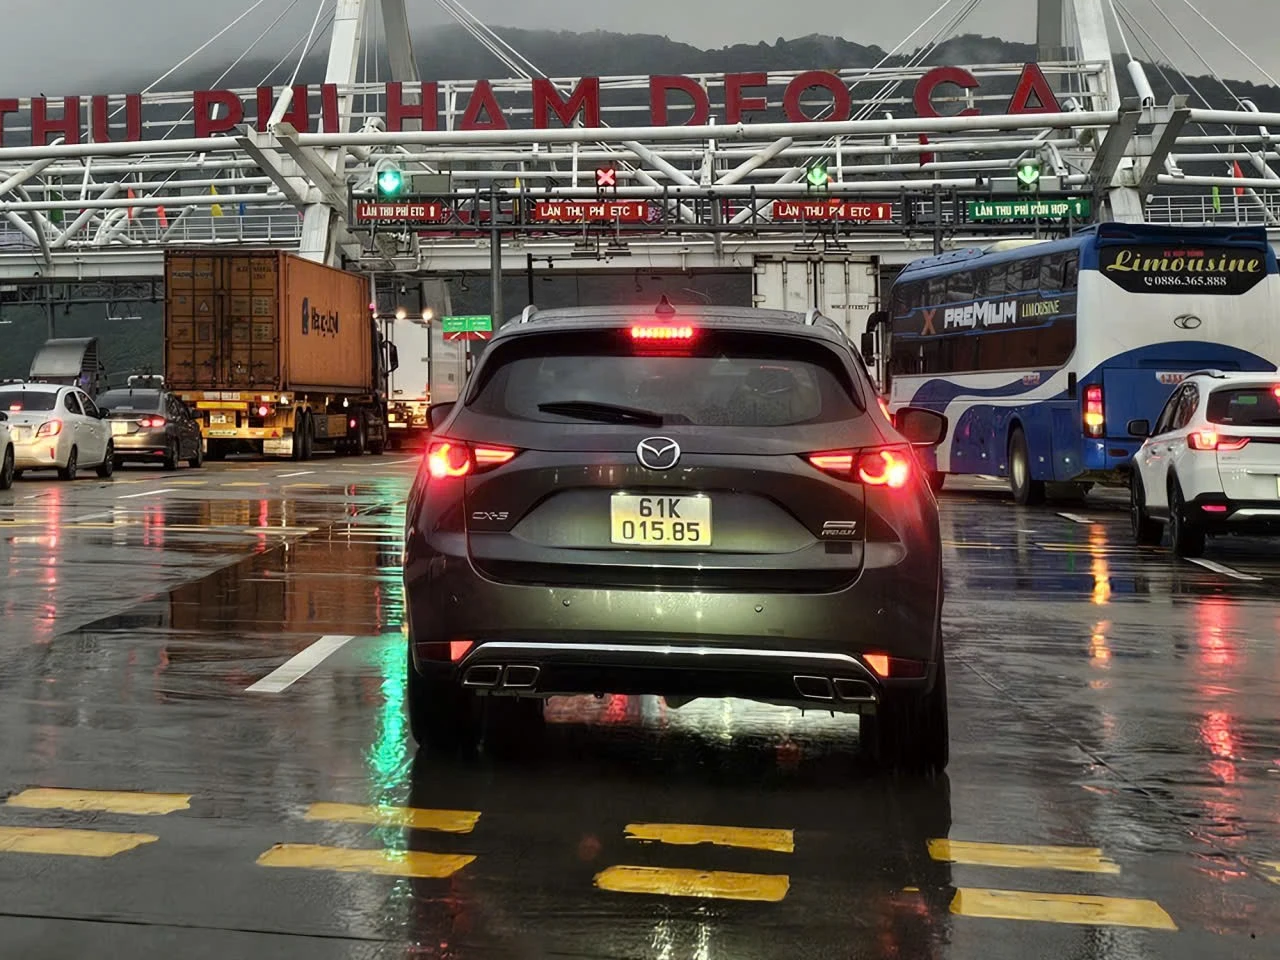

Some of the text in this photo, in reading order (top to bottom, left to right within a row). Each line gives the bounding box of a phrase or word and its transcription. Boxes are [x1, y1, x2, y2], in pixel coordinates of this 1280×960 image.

[385, 76, 601, 132] HAM
[380, 206, 394, 217] THU
[410, 206, 425, 217] ETC
[610, 206, 630, 216] ETC
[804, 206, 824, 217] THU
[850, 207, 871, 217] ETC
[995, 205, 1012, 216] THU
[1106, 250, 1262, 273] Limousine
[1154, 276, 1227, 287] 0886.365.888
[943, 300, 1017, 329] PREMIUM
[639, 498, 681, 518] 61K
[622, 520, 700, 541] 015.85
